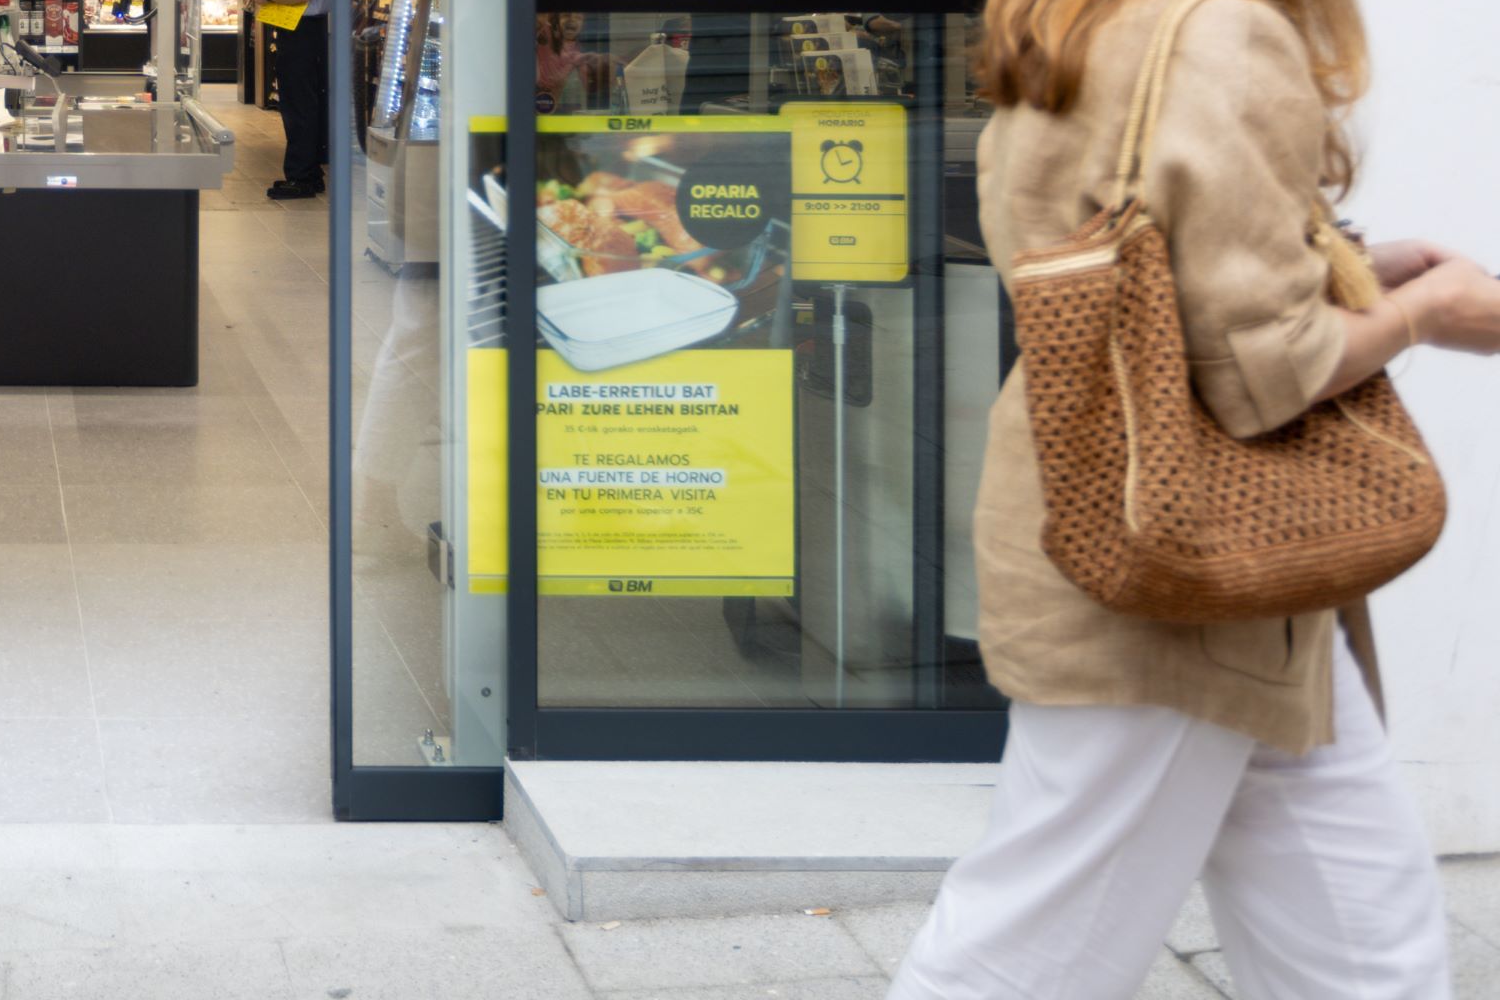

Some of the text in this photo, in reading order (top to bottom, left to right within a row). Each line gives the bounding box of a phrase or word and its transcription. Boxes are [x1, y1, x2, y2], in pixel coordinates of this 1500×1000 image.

[626, 119, 652, 130] BM
[819, 119, 866, 128] HORARIO
[691, 185, 759, 199] OPARIA
[690, 204, 761, 218] REGALO
[804, 202, 831, 211] 9:00
[851, 202, 881, 211] 21:00
[548, 385, 714, 398] LABE-ERRETILU BAT
[536, 403, 739, 416] PARI ZURE LEHEN BISITAN
[573, 454, 690, 466] TE REGALAMOS
[539, 471, 722, 484] UNA FUENTE DE HORNO
[547, 488, 716, 501] EN TU PRIMERA VISITA
[599, 506, 633, 516] compra
[626, 580, 652, 592] BM
